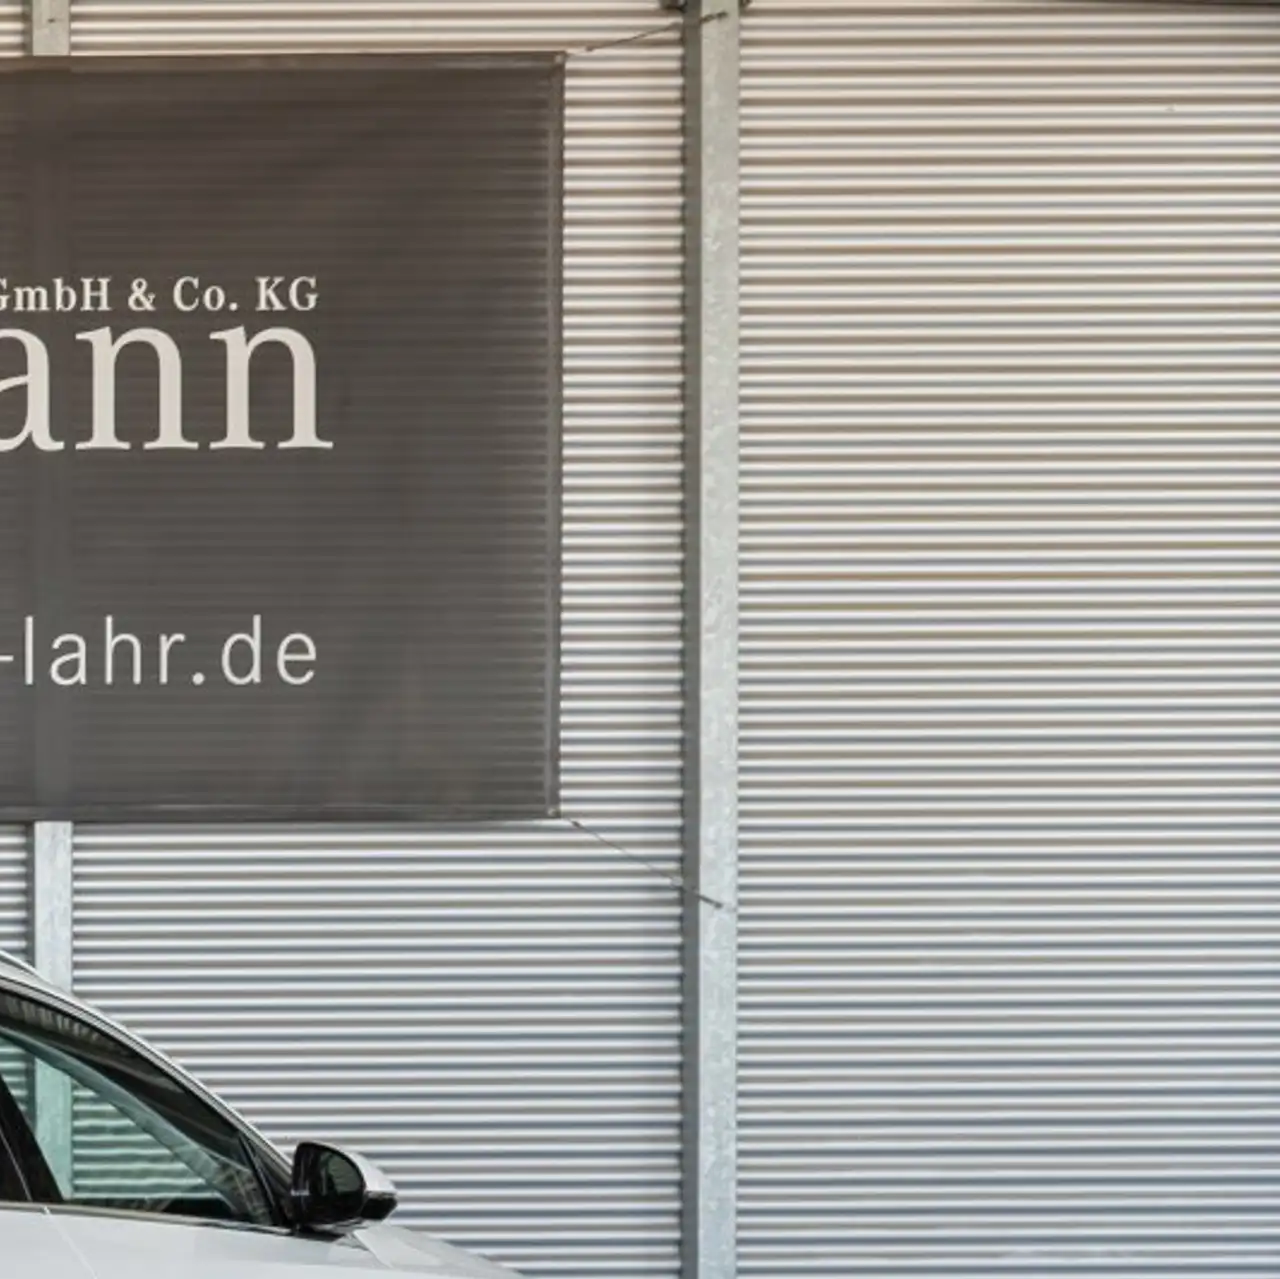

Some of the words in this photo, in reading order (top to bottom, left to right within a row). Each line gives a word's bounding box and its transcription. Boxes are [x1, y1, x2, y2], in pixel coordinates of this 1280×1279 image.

[127, 278, 156, 312] &
[173, 276, 238, 312] Co.
[256, 276, 319, 312] KG
